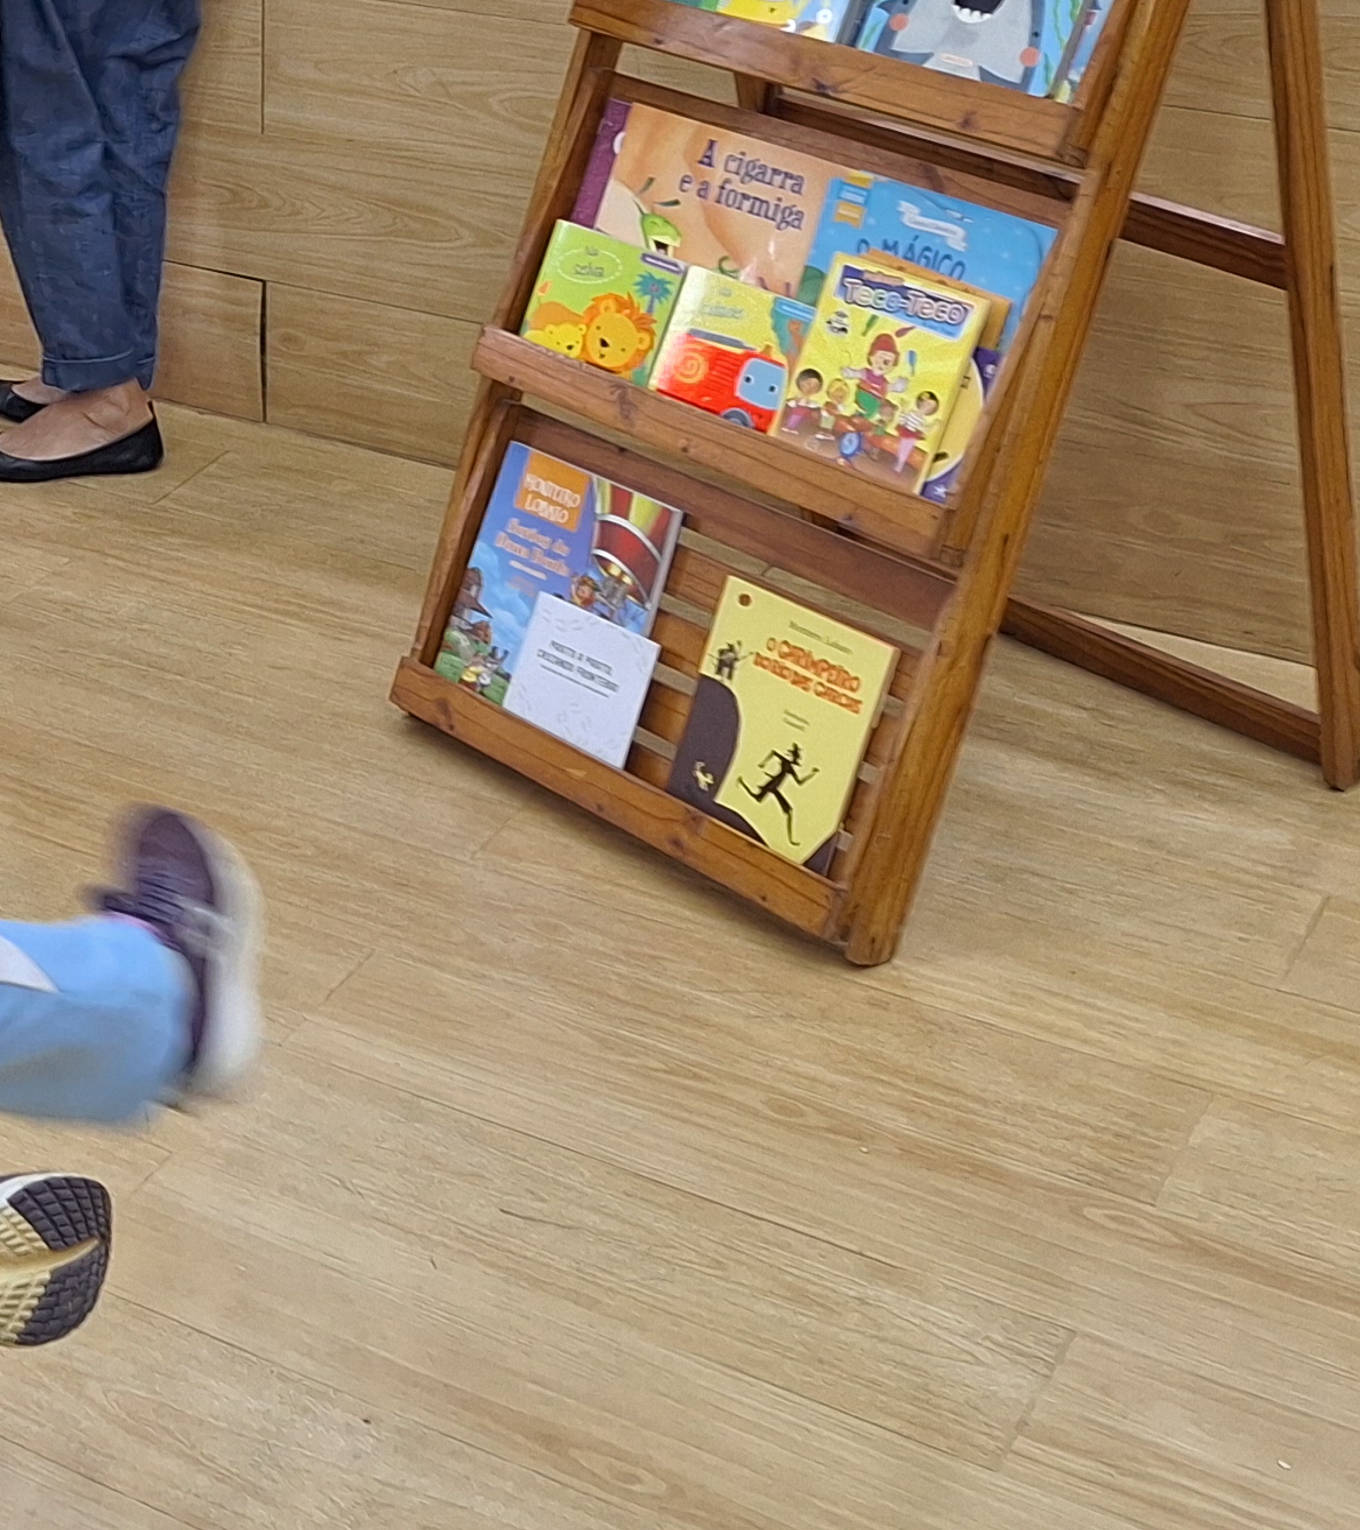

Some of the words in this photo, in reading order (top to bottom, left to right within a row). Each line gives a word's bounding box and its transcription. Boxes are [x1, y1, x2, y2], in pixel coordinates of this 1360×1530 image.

[697, 139, 718, 168] A
[723, 151, 806, 196] cigarra
[678, 173, 694, 193] e
[696, 180, 711, 200] a
[714, 177, 806, 231] formiga
[881, 235, 967, 280] MÁGICO
[524, 493, 570, 524] LOBATO
